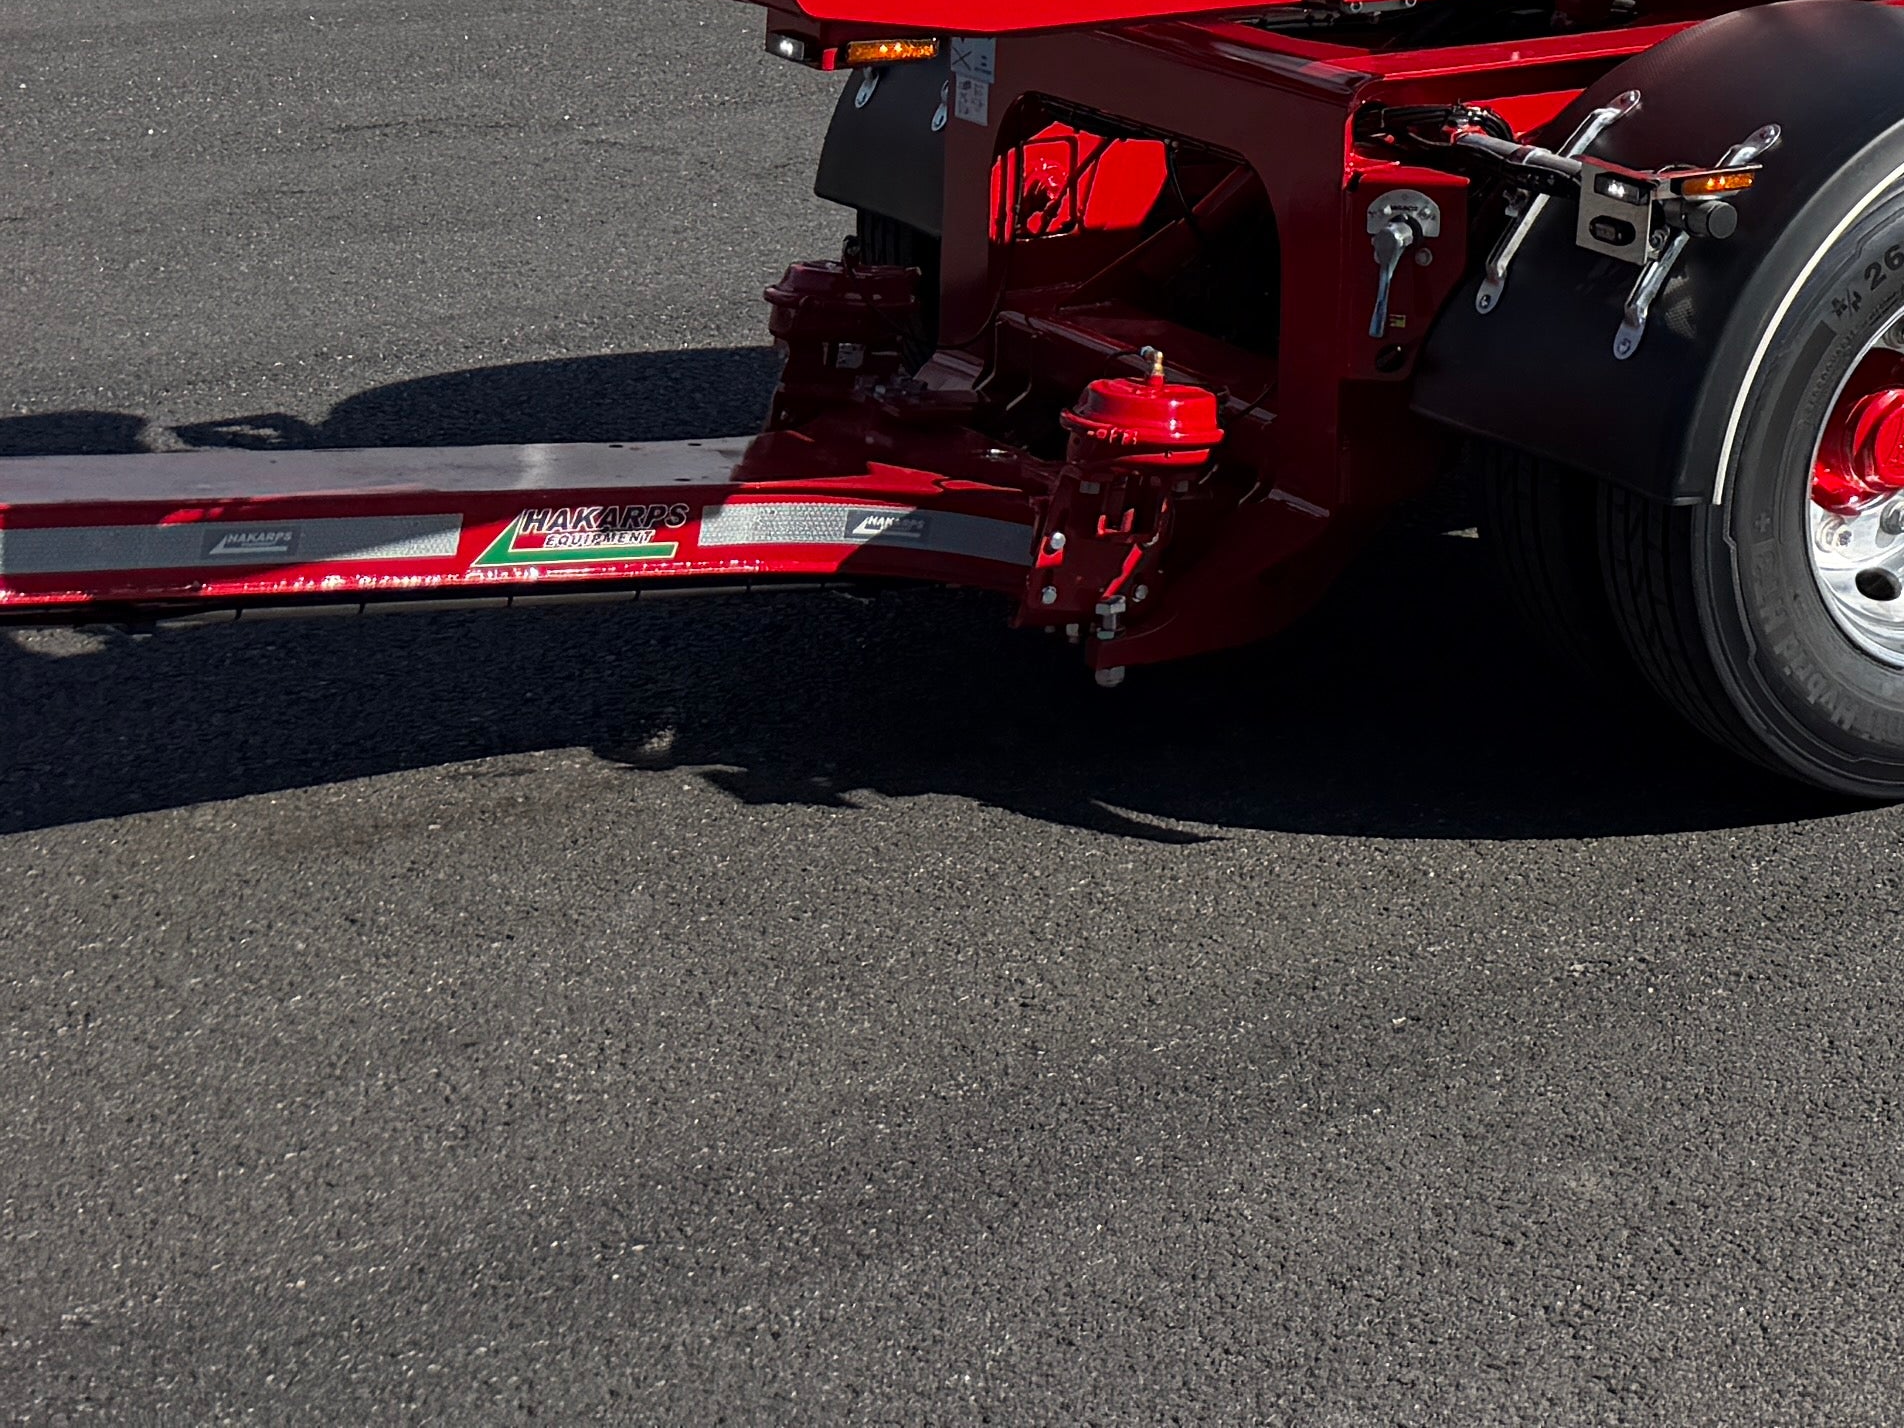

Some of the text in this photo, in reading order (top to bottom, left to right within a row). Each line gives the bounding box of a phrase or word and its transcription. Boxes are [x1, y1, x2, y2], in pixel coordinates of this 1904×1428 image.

[522, 503, 689, 534] HAKARPS
[225, 530, 293, 543] HAKARPS
[545, 530, 654, 549] EQUIPMENT
[1772, 635, 1860, 731] Hybrid
